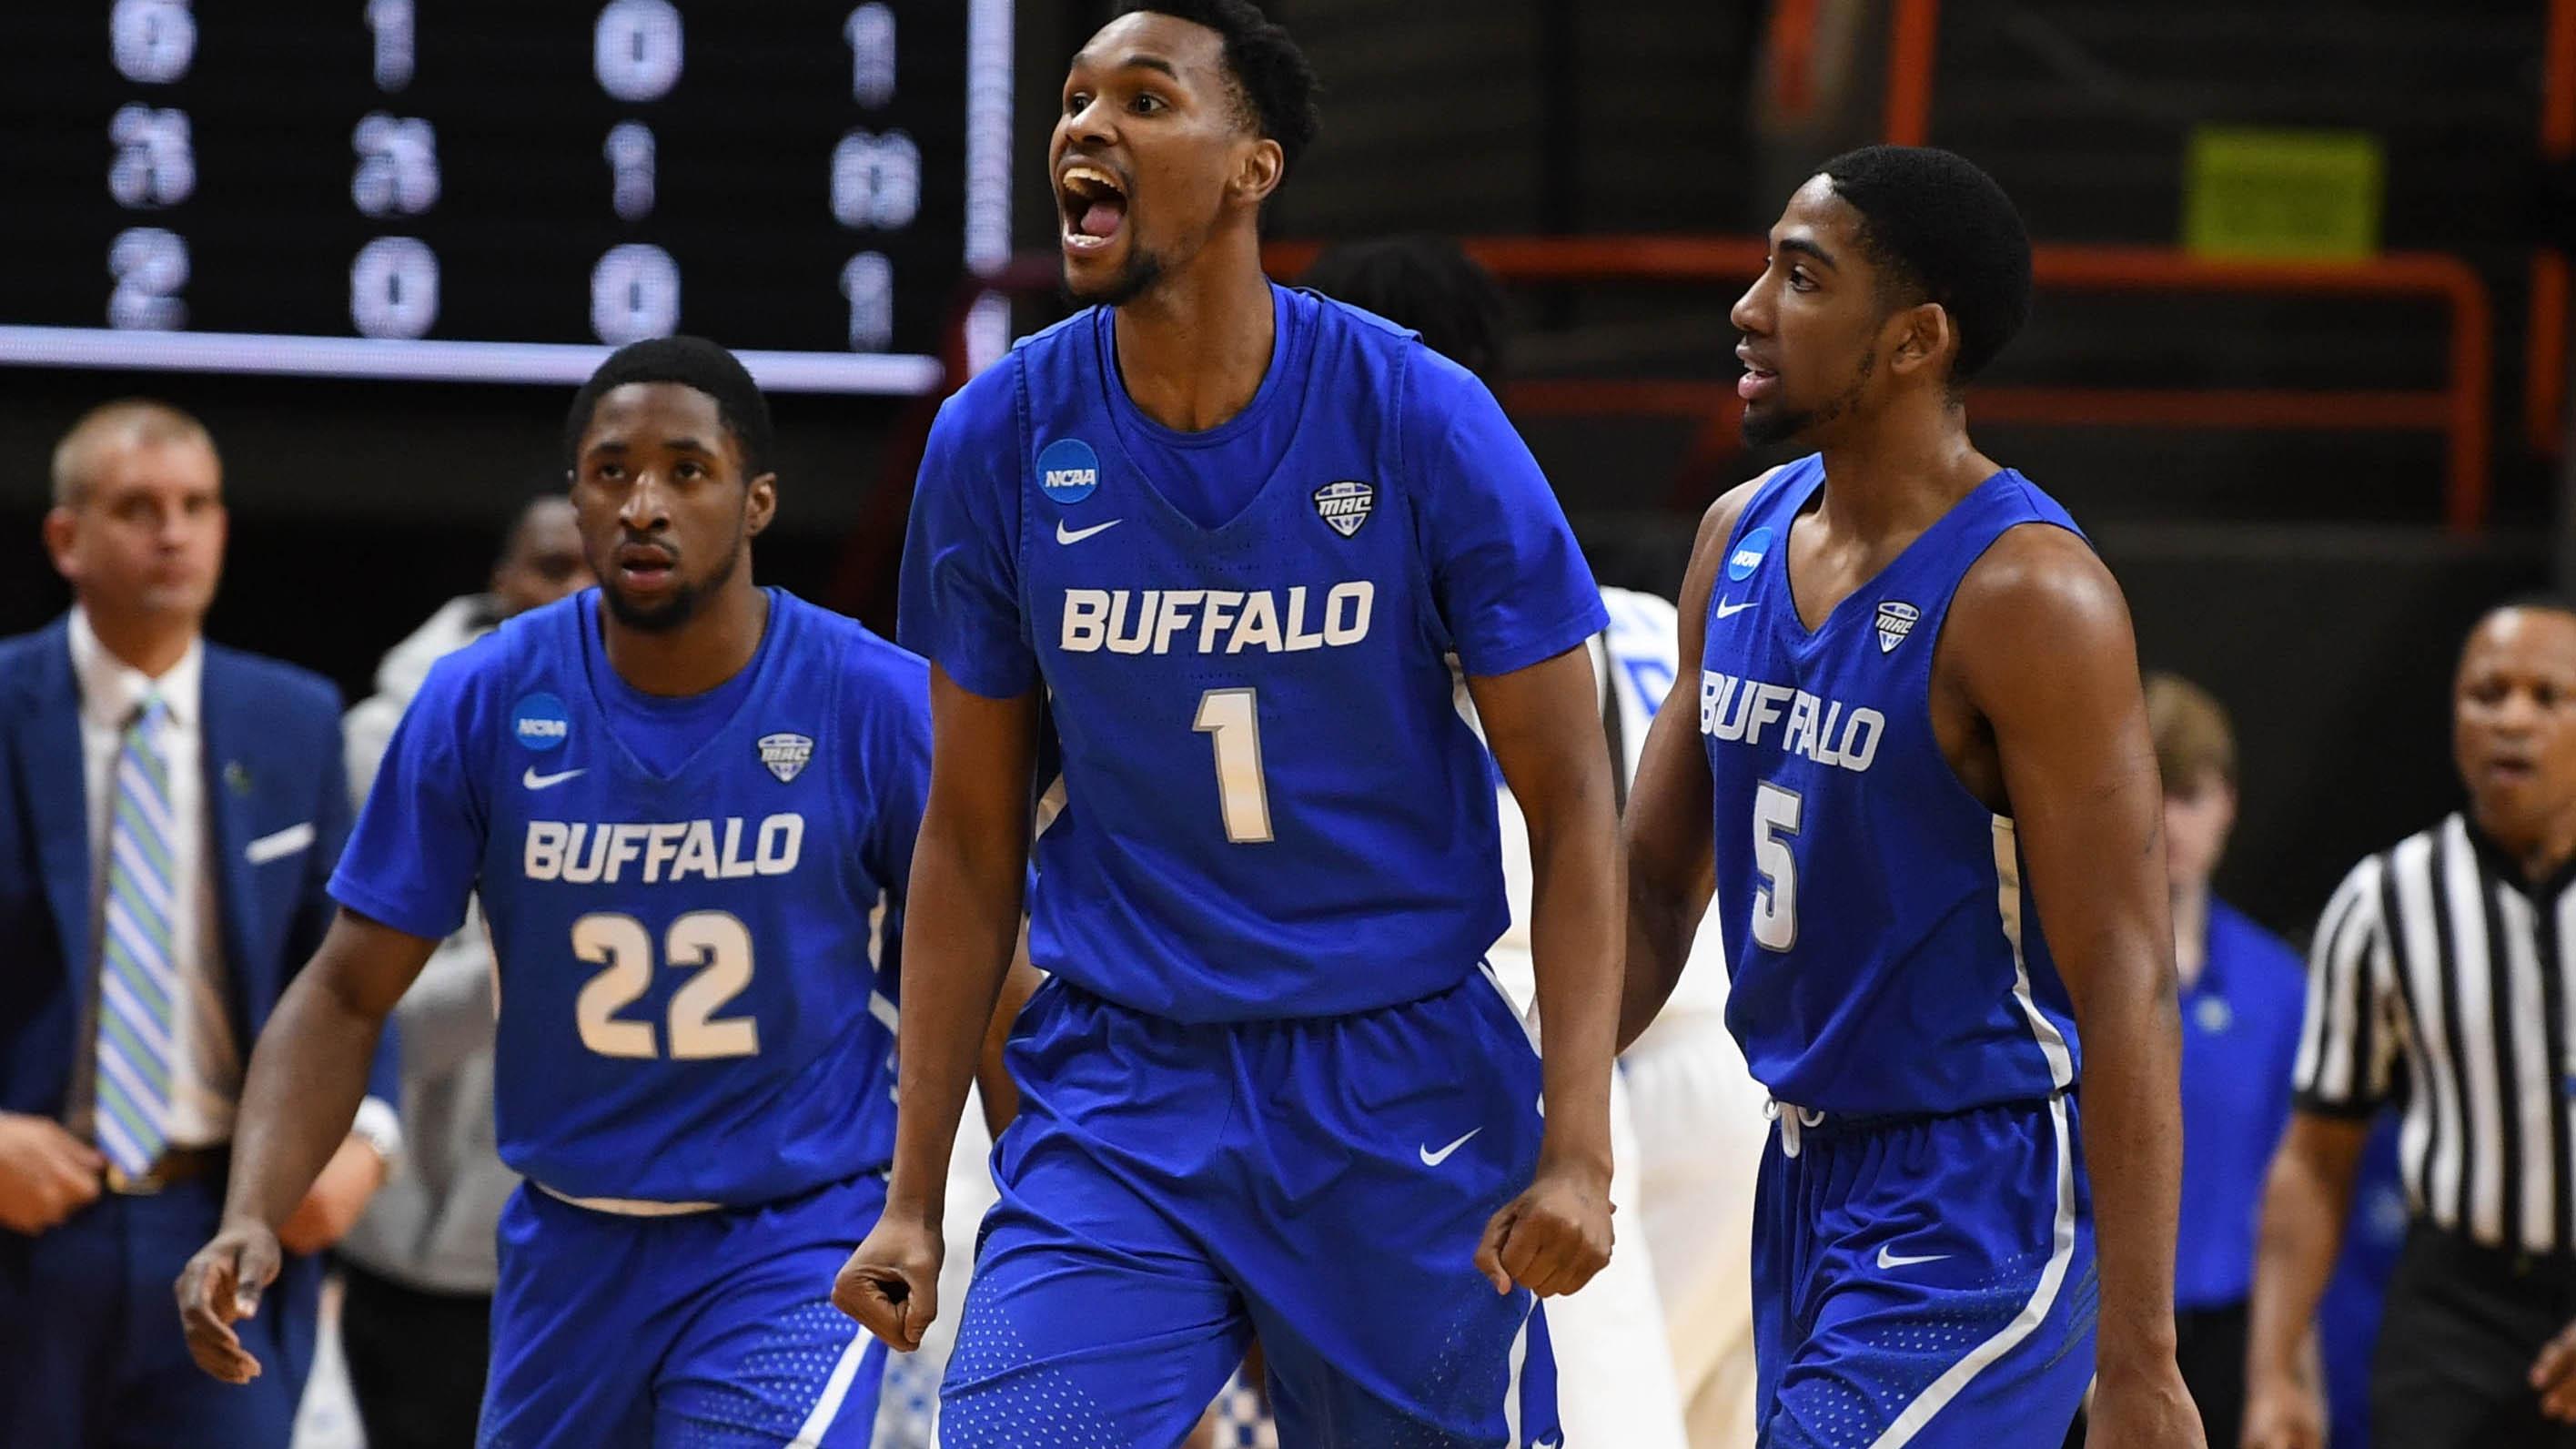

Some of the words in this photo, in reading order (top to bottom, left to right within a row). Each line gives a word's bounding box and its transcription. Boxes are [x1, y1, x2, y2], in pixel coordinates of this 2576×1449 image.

[1046, 469, 1096, 487] NCAA
[1318, 496, 1371, 515] MAC
[1060, 581, 1374, 654] BUFFALO
[1875, 613, 1914, 633] MAC
[1700, 670, 1885, 772] BUFFALO
[1192, 687, 1274, 843] 1
[524, 813, 804, 883] BUFFALO
[1752, 779, 1803, 952] 5
[571, 911, 759, 1059] 22
